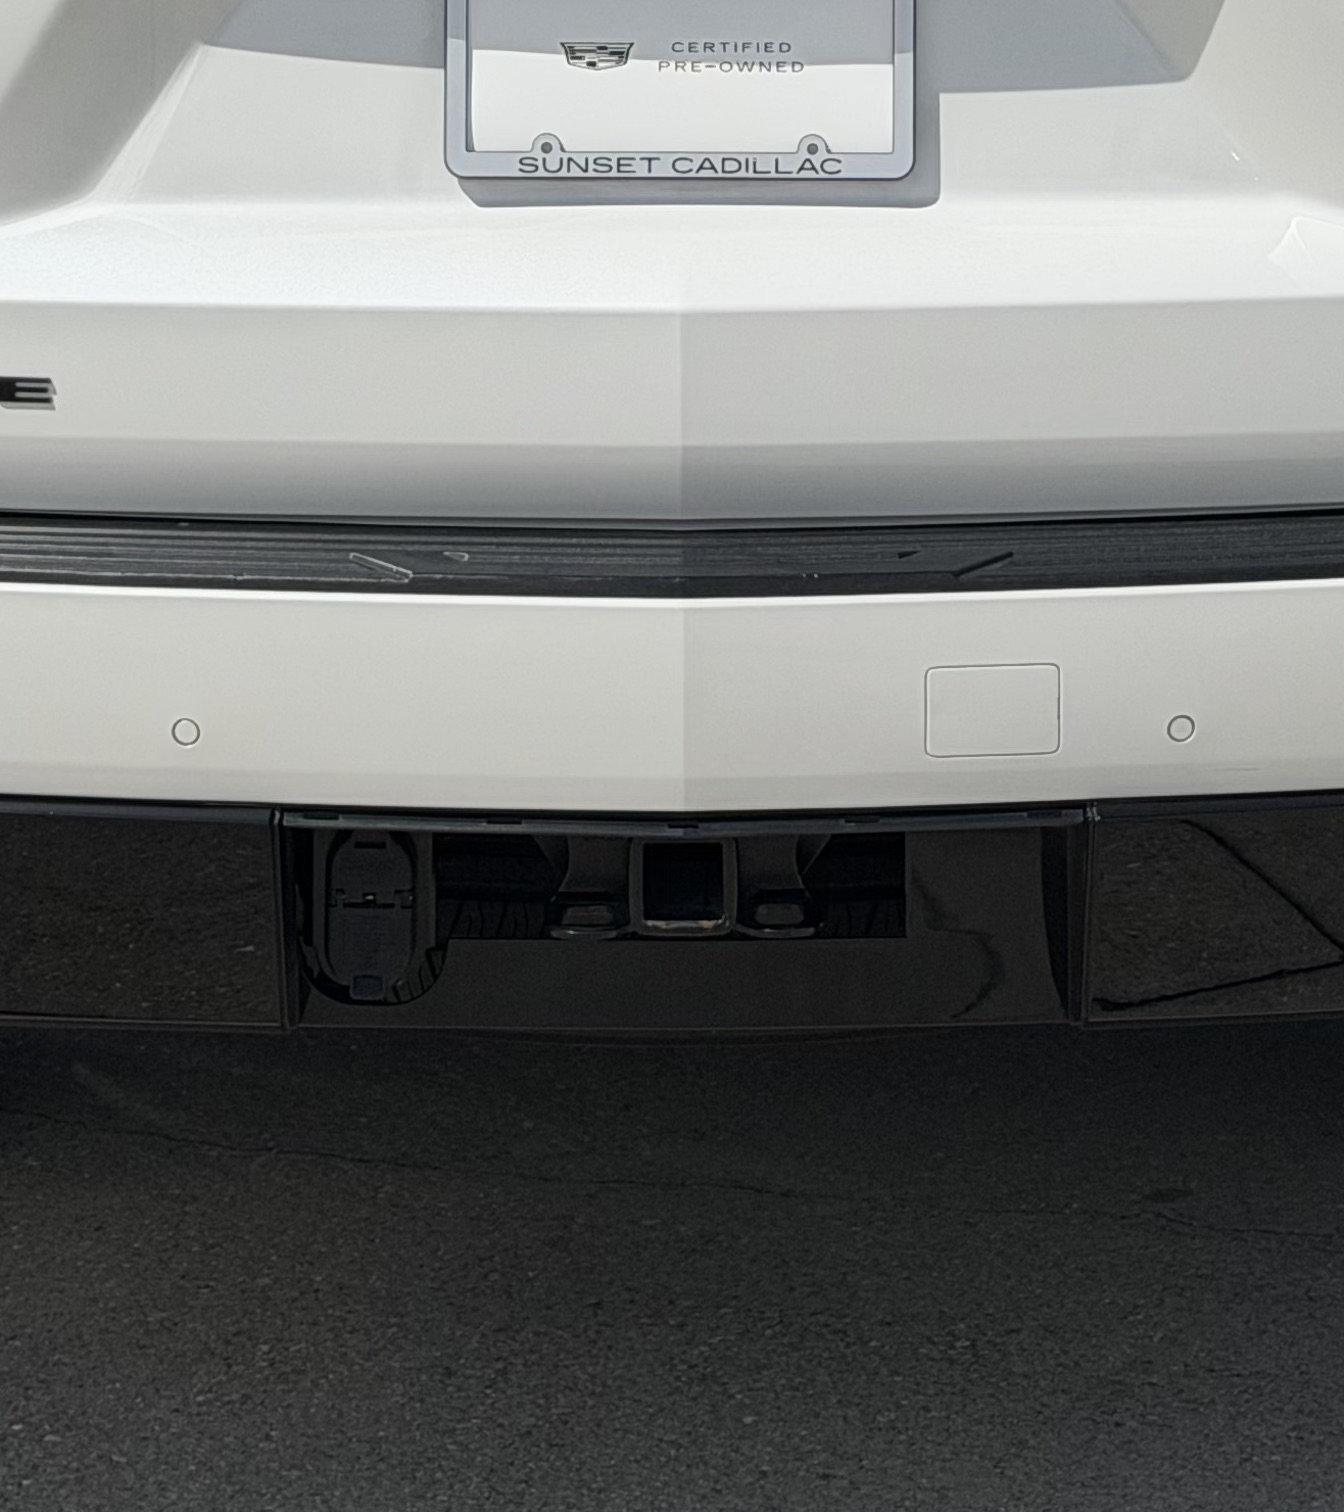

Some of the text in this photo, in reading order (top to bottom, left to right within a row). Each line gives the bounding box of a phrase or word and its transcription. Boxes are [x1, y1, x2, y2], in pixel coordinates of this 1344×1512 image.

[671, 41, 792, 54] CERTIFIED
[657, 61, 805, 73] PRE-OWNED
[518, 157, 843, 175] SUNSET CADILLAC
